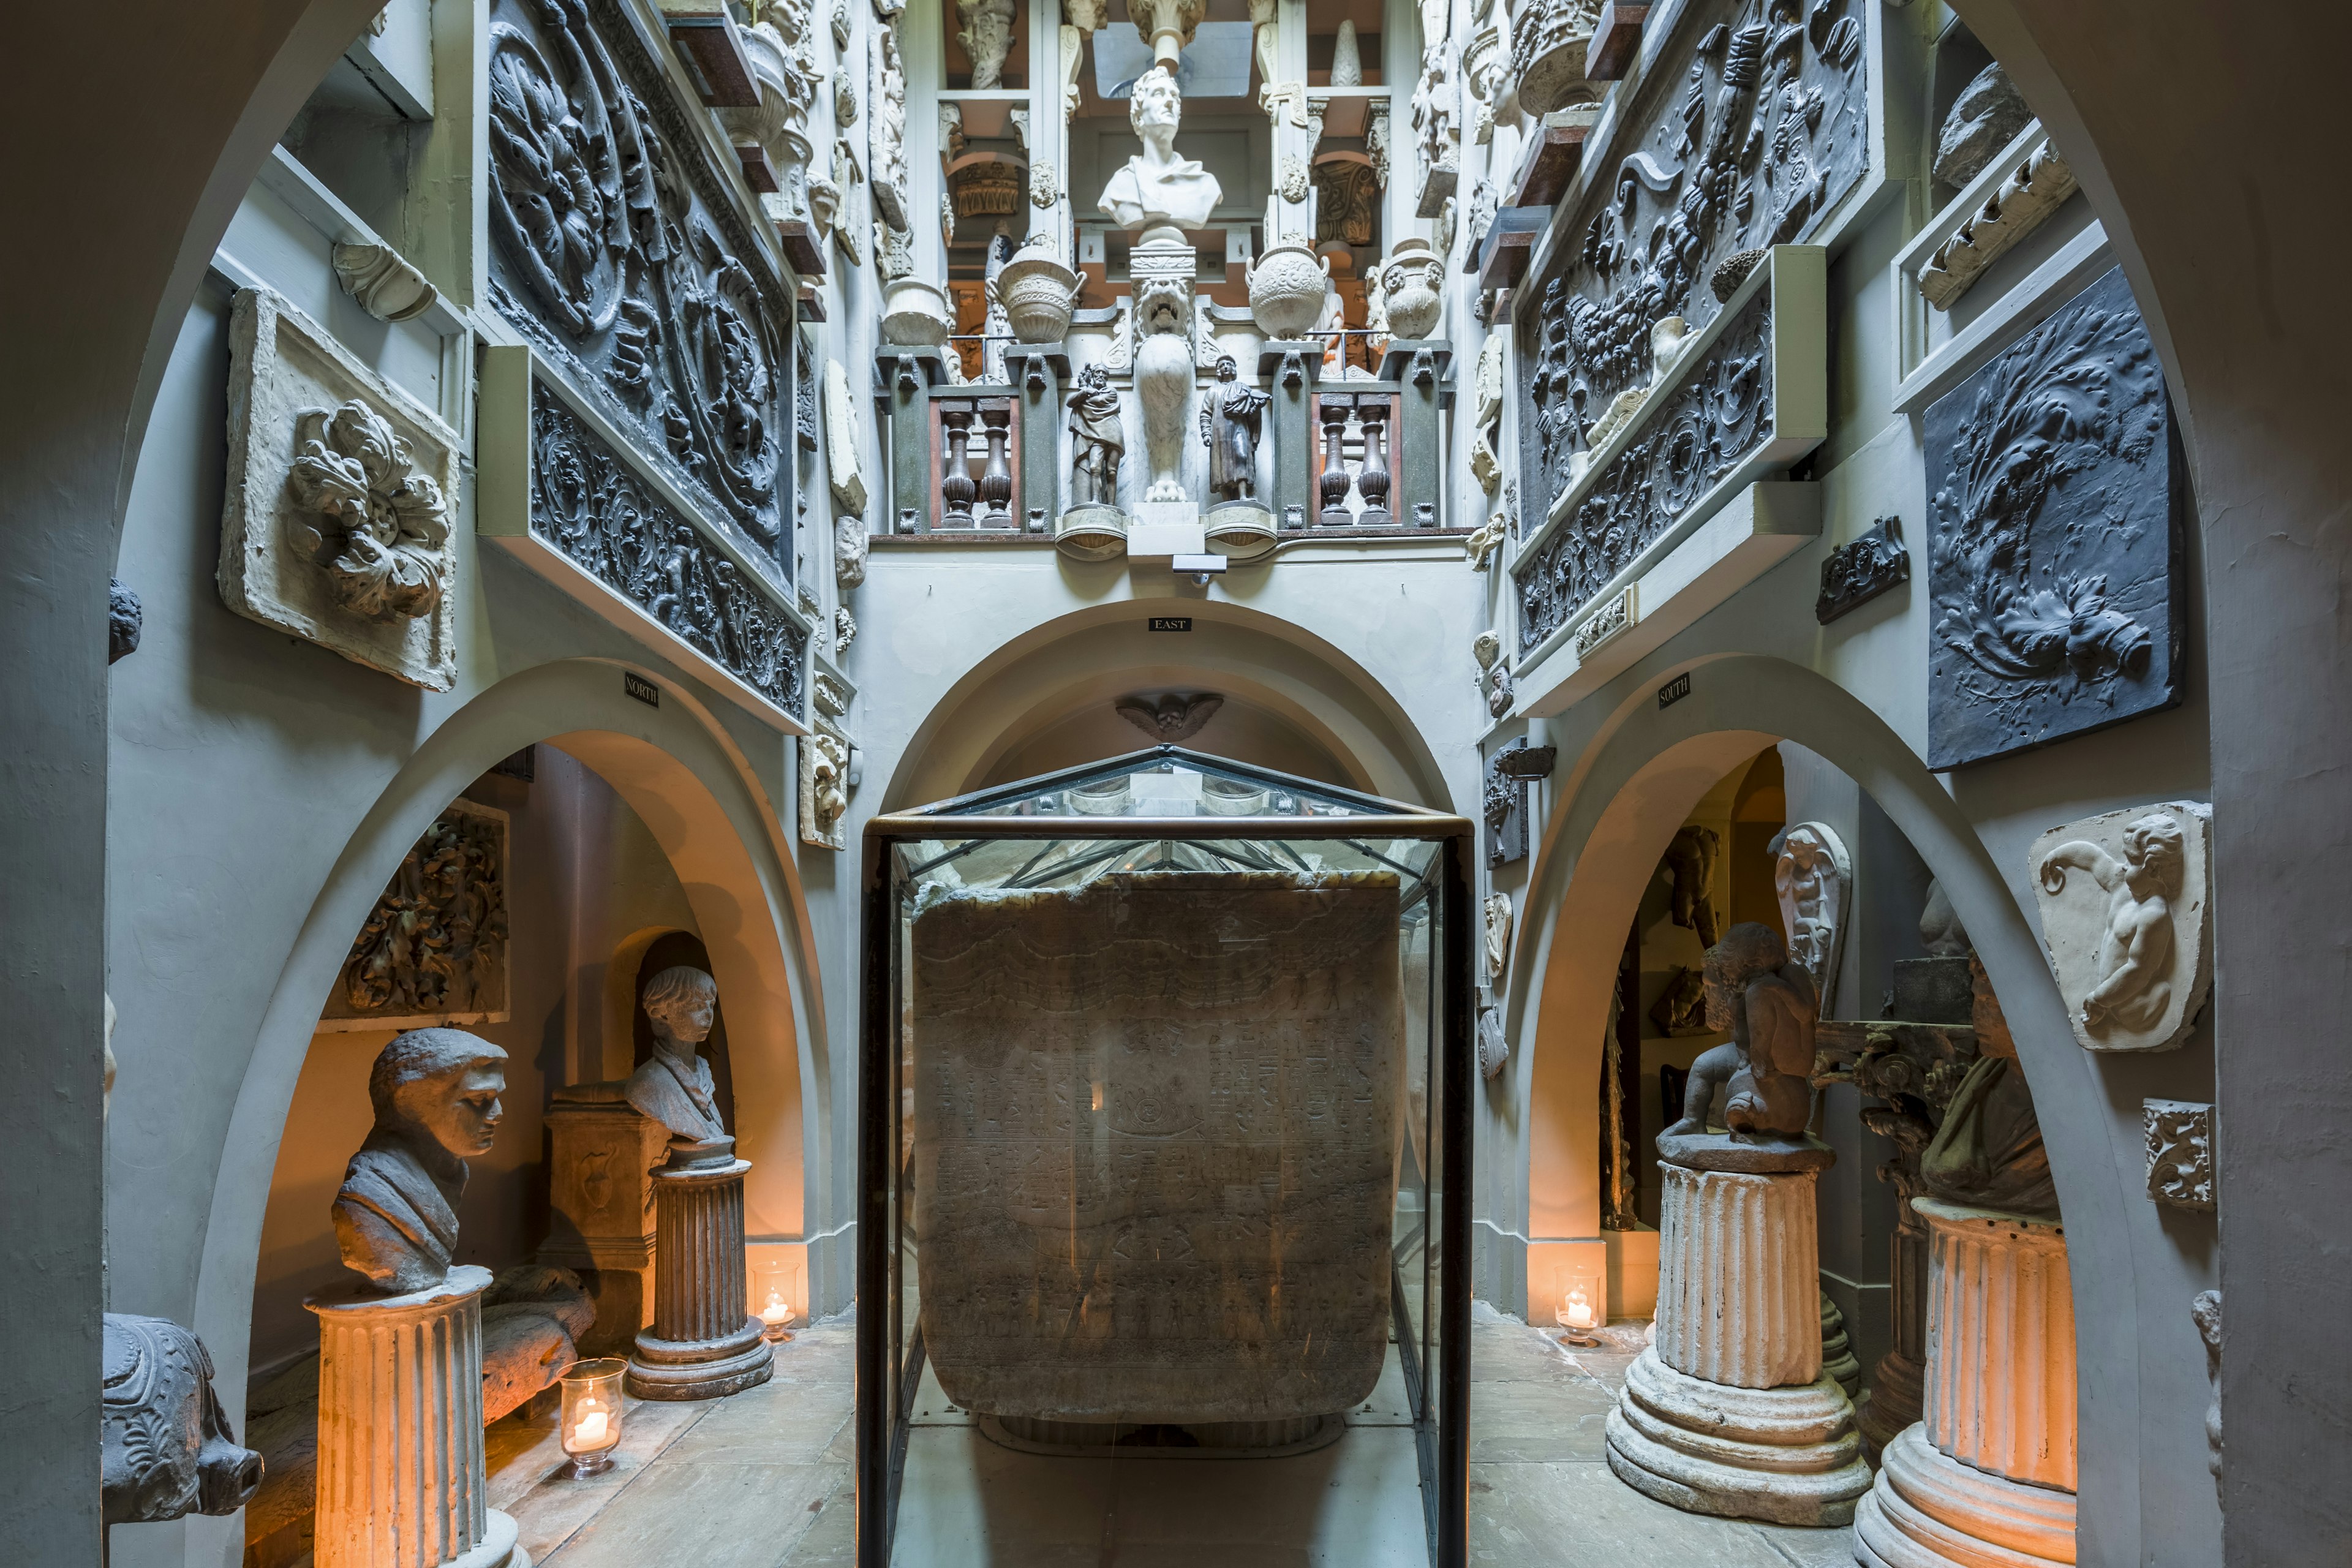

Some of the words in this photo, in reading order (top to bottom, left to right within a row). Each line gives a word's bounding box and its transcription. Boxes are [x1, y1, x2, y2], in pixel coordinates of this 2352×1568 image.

[1155, 620, 1186, 629] EAST
[626, 676, 657, 703] NORTH
[1660, 677, 1687, 705] SOUTH
